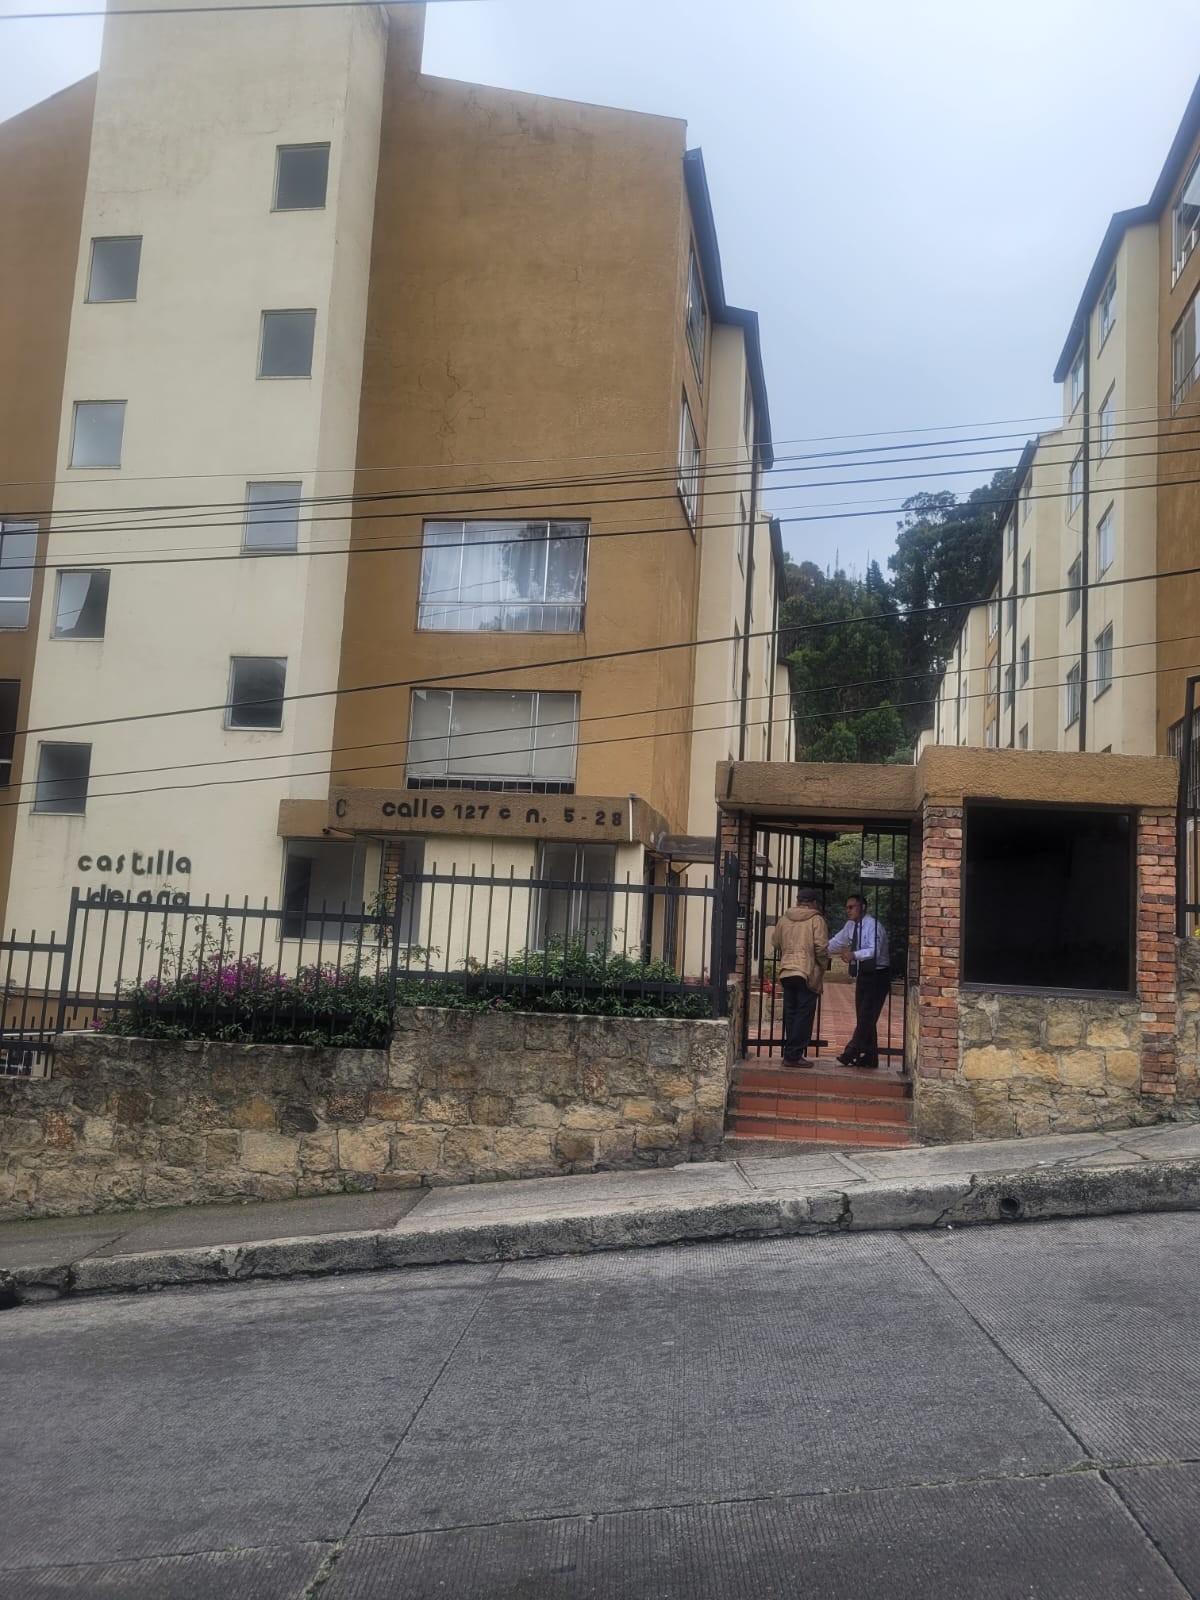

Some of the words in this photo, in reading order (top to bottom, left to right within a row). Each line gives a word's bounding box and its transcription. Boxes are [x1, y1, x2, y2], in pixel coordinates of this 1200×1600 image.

[382, 798, 445, 819] calle
[454, 804, 490, 820] 127
[77, 849, 192, 876] castilla
